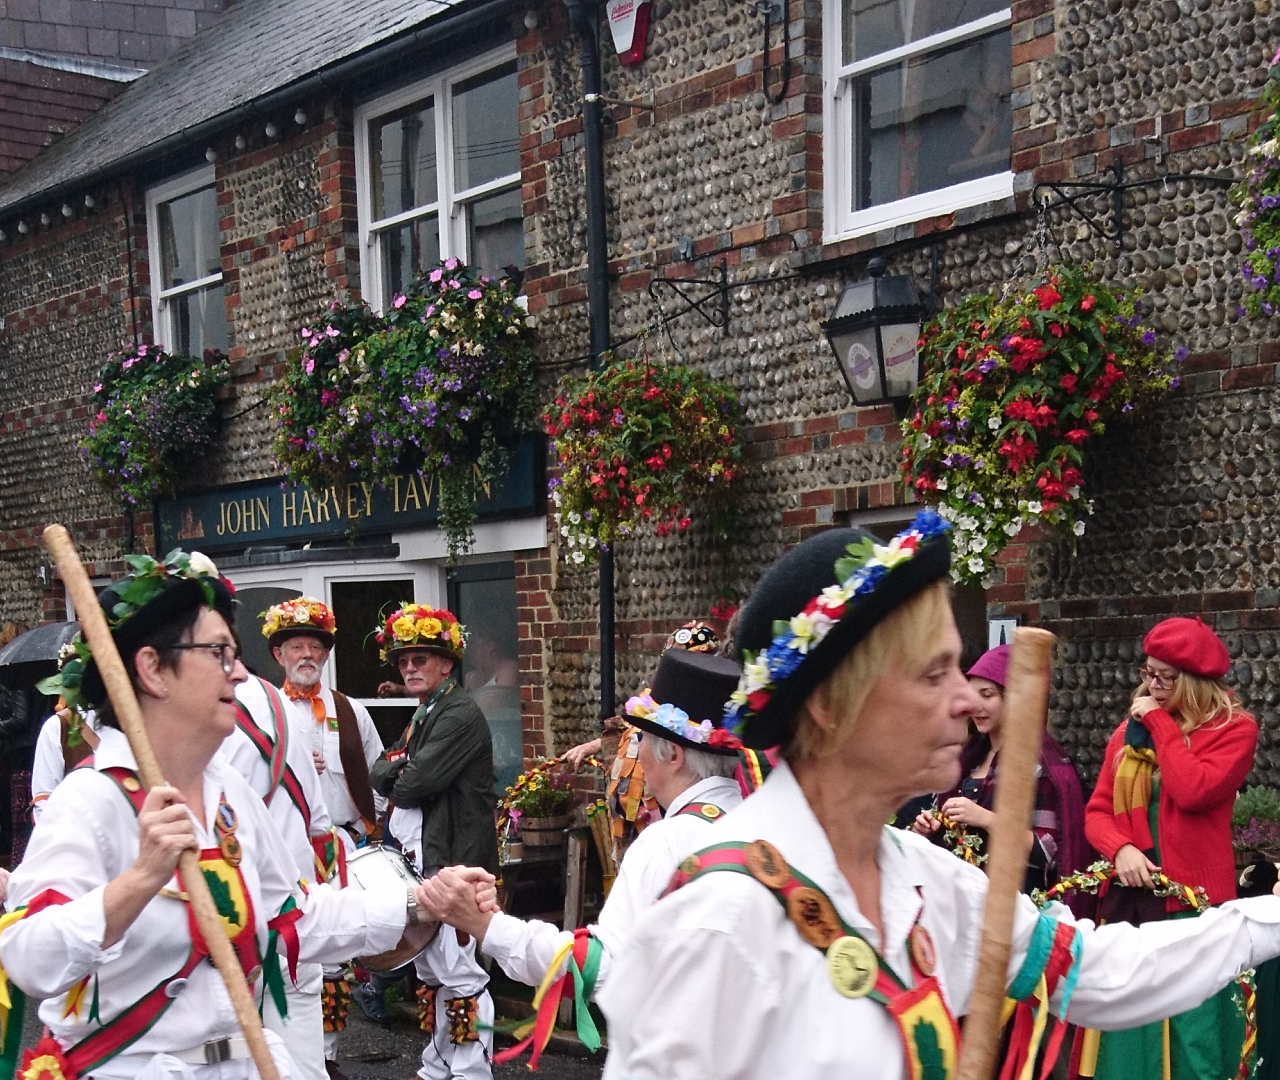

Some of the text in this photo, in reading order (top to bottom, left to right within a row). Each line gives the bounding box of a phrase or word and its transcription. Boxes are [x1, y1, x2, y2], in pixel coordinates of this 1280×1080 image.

[216, 463, 491, 536] JOHN HARVEY TAVN
